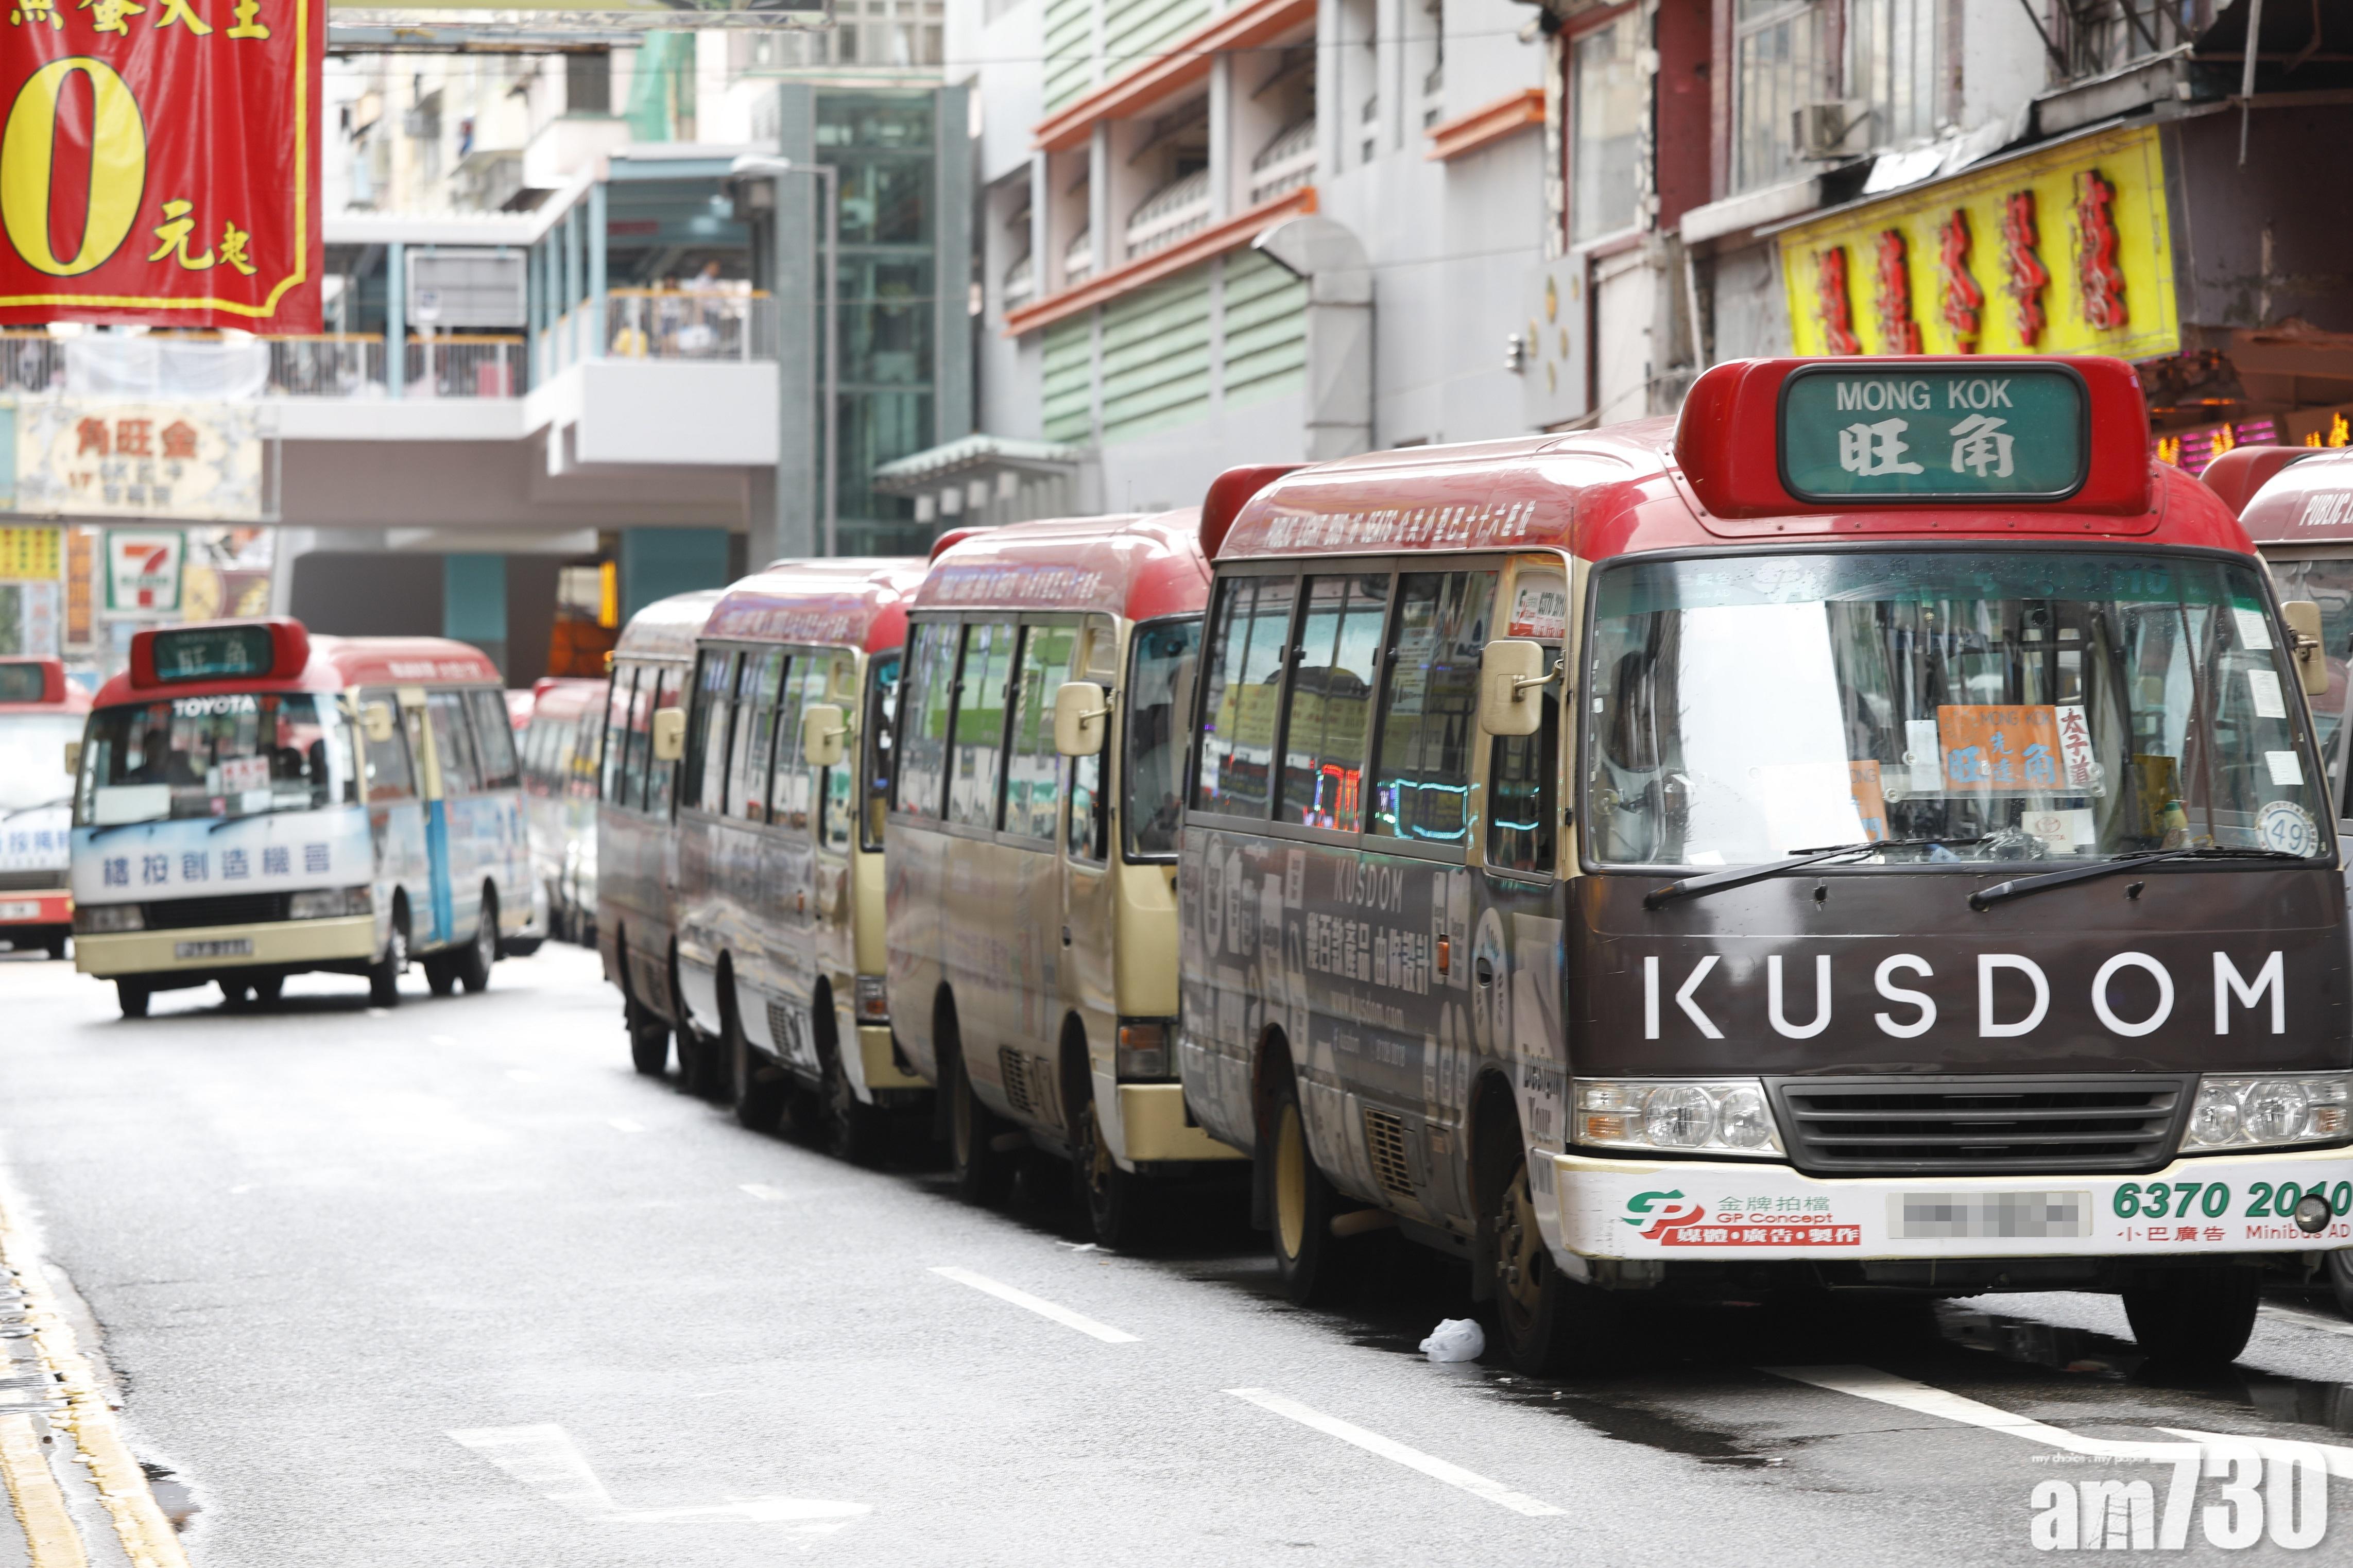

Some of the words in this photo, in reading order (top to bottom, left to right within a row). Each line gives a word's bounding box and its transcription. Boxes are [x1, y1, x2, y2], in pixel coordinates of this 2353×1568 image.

[1837, 381, 1930, 411] MONG
[1949, 379, 2013, 409] KOK
[1839, 413, 2014, 477] 旺角
[2298, 493, 2351, 526] PUBLIC
[173, 694, 256, 717] TOYOTA
[1981, 711, 2019, 725] MONG
[2026, 711, 2053, 725] KOK
[2271, 819, 2302, 851] 49
[1334, 858, 1403, 914] KUSDOM
[1644, 951, 2285, 1039] KUSDOM
[1718, 1196, 1830, 1212] 金牌拍檔
[2113, 1182, 2230, 1218] 6370
[1717, 1213, 1743, 1224] GP
[1750, 1212, 1833, 1226] Concept
[2117, 1226, 2227, 1242] 小巴廣告
[2328, 1224, 2351, 1238] AD
